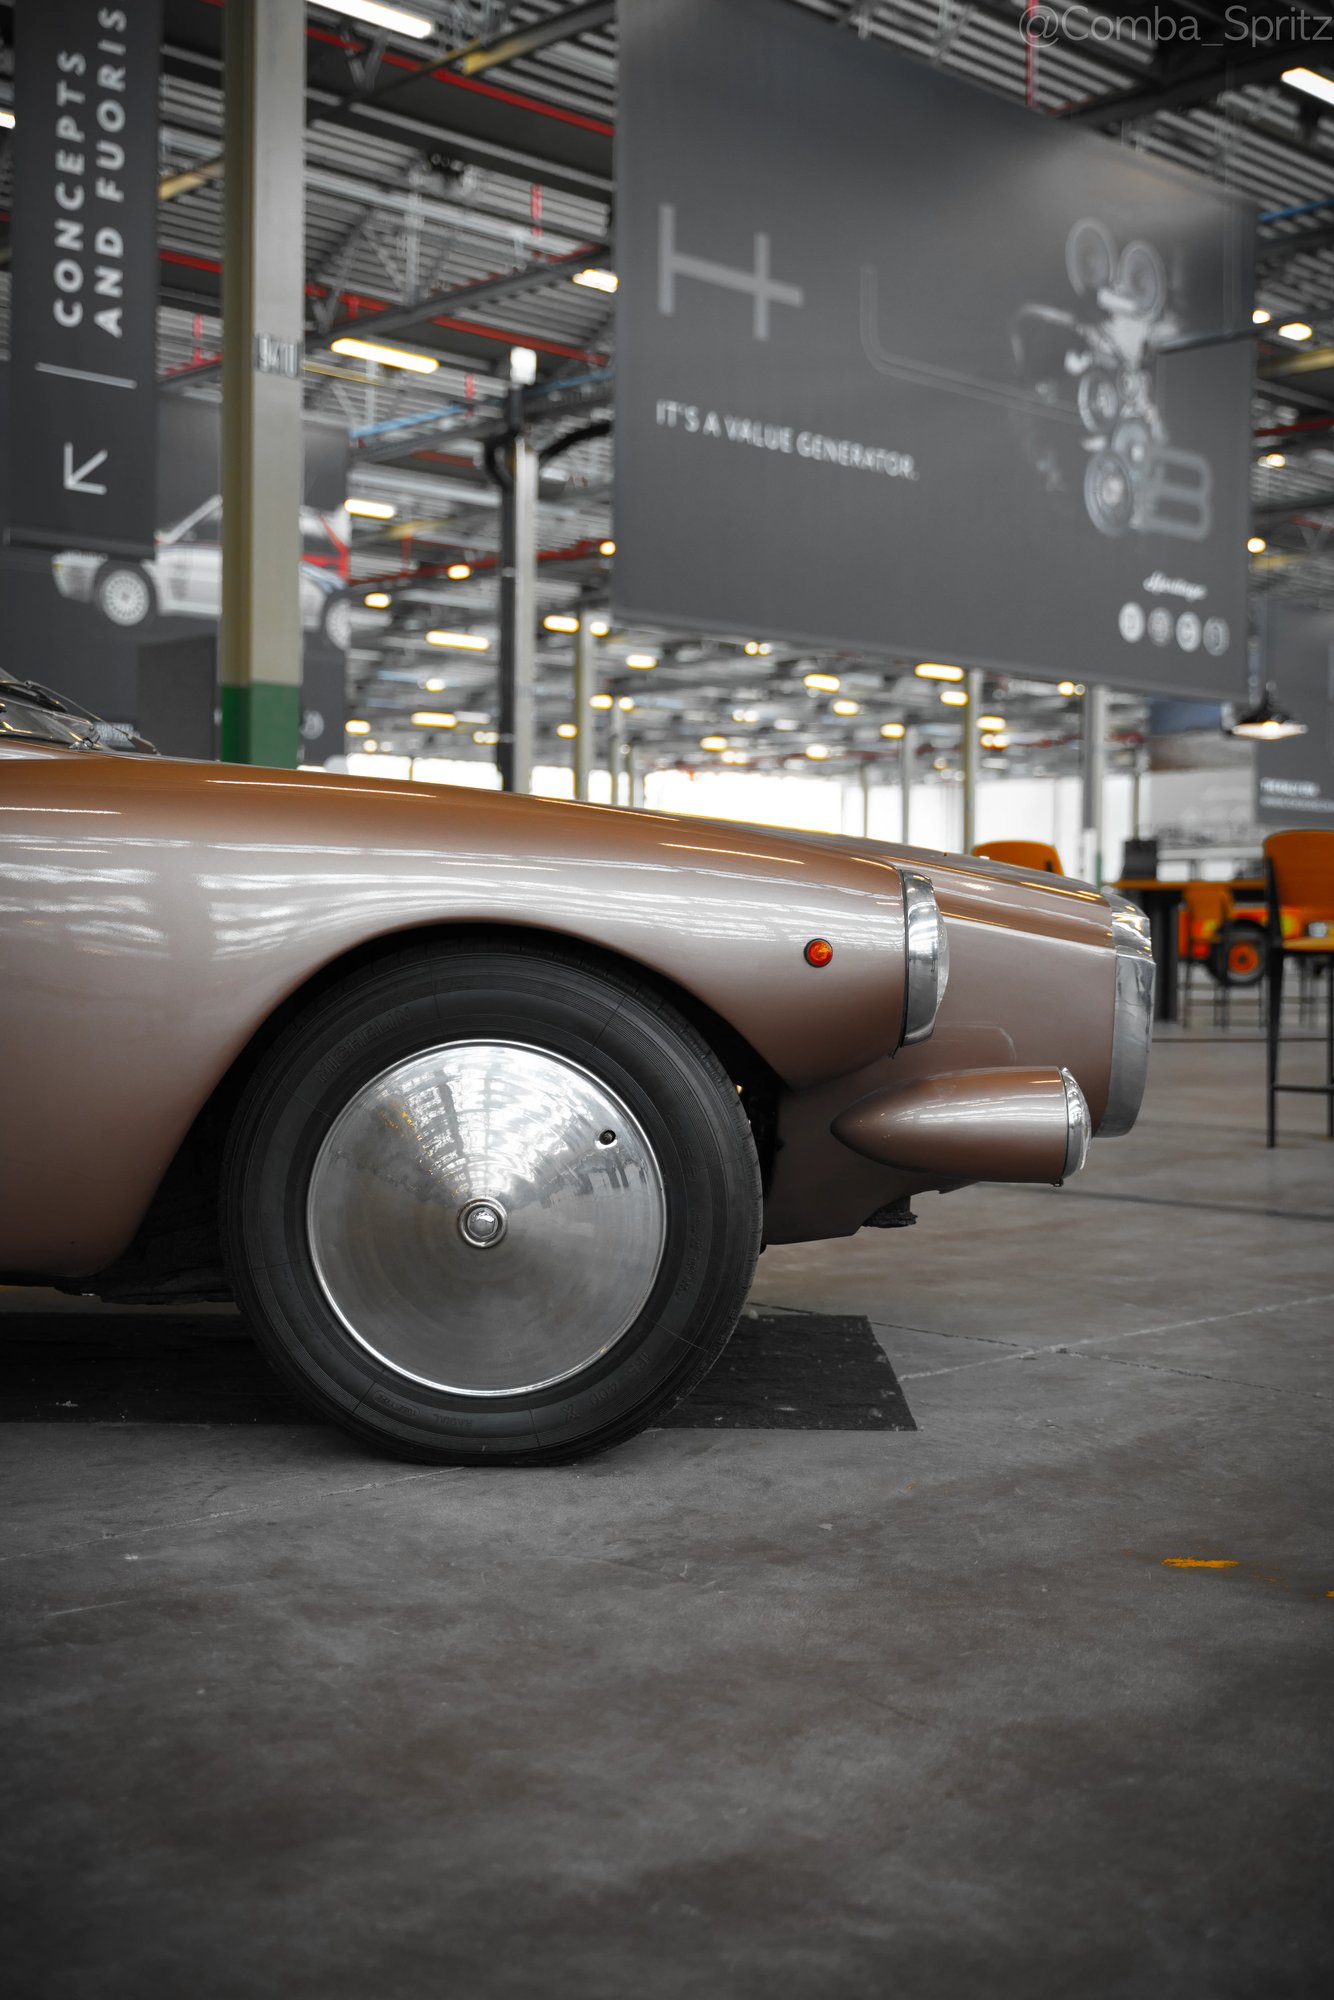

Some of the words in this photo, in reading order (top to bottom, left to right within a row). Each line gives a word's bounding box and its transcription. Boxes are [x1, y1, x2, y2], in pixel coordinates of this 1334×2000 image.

[95, 6, 127, 203] FUORIS
[53, 50, 87, 328] CONCEPTS
[93, 226, 125, 338] AND
[656, 398, 700, 432] IT'S
[702, 410, 722, 438] A
[724, 414, 795, 454] VALUE
[311, 1005, 414, 1084] MICHELIN
